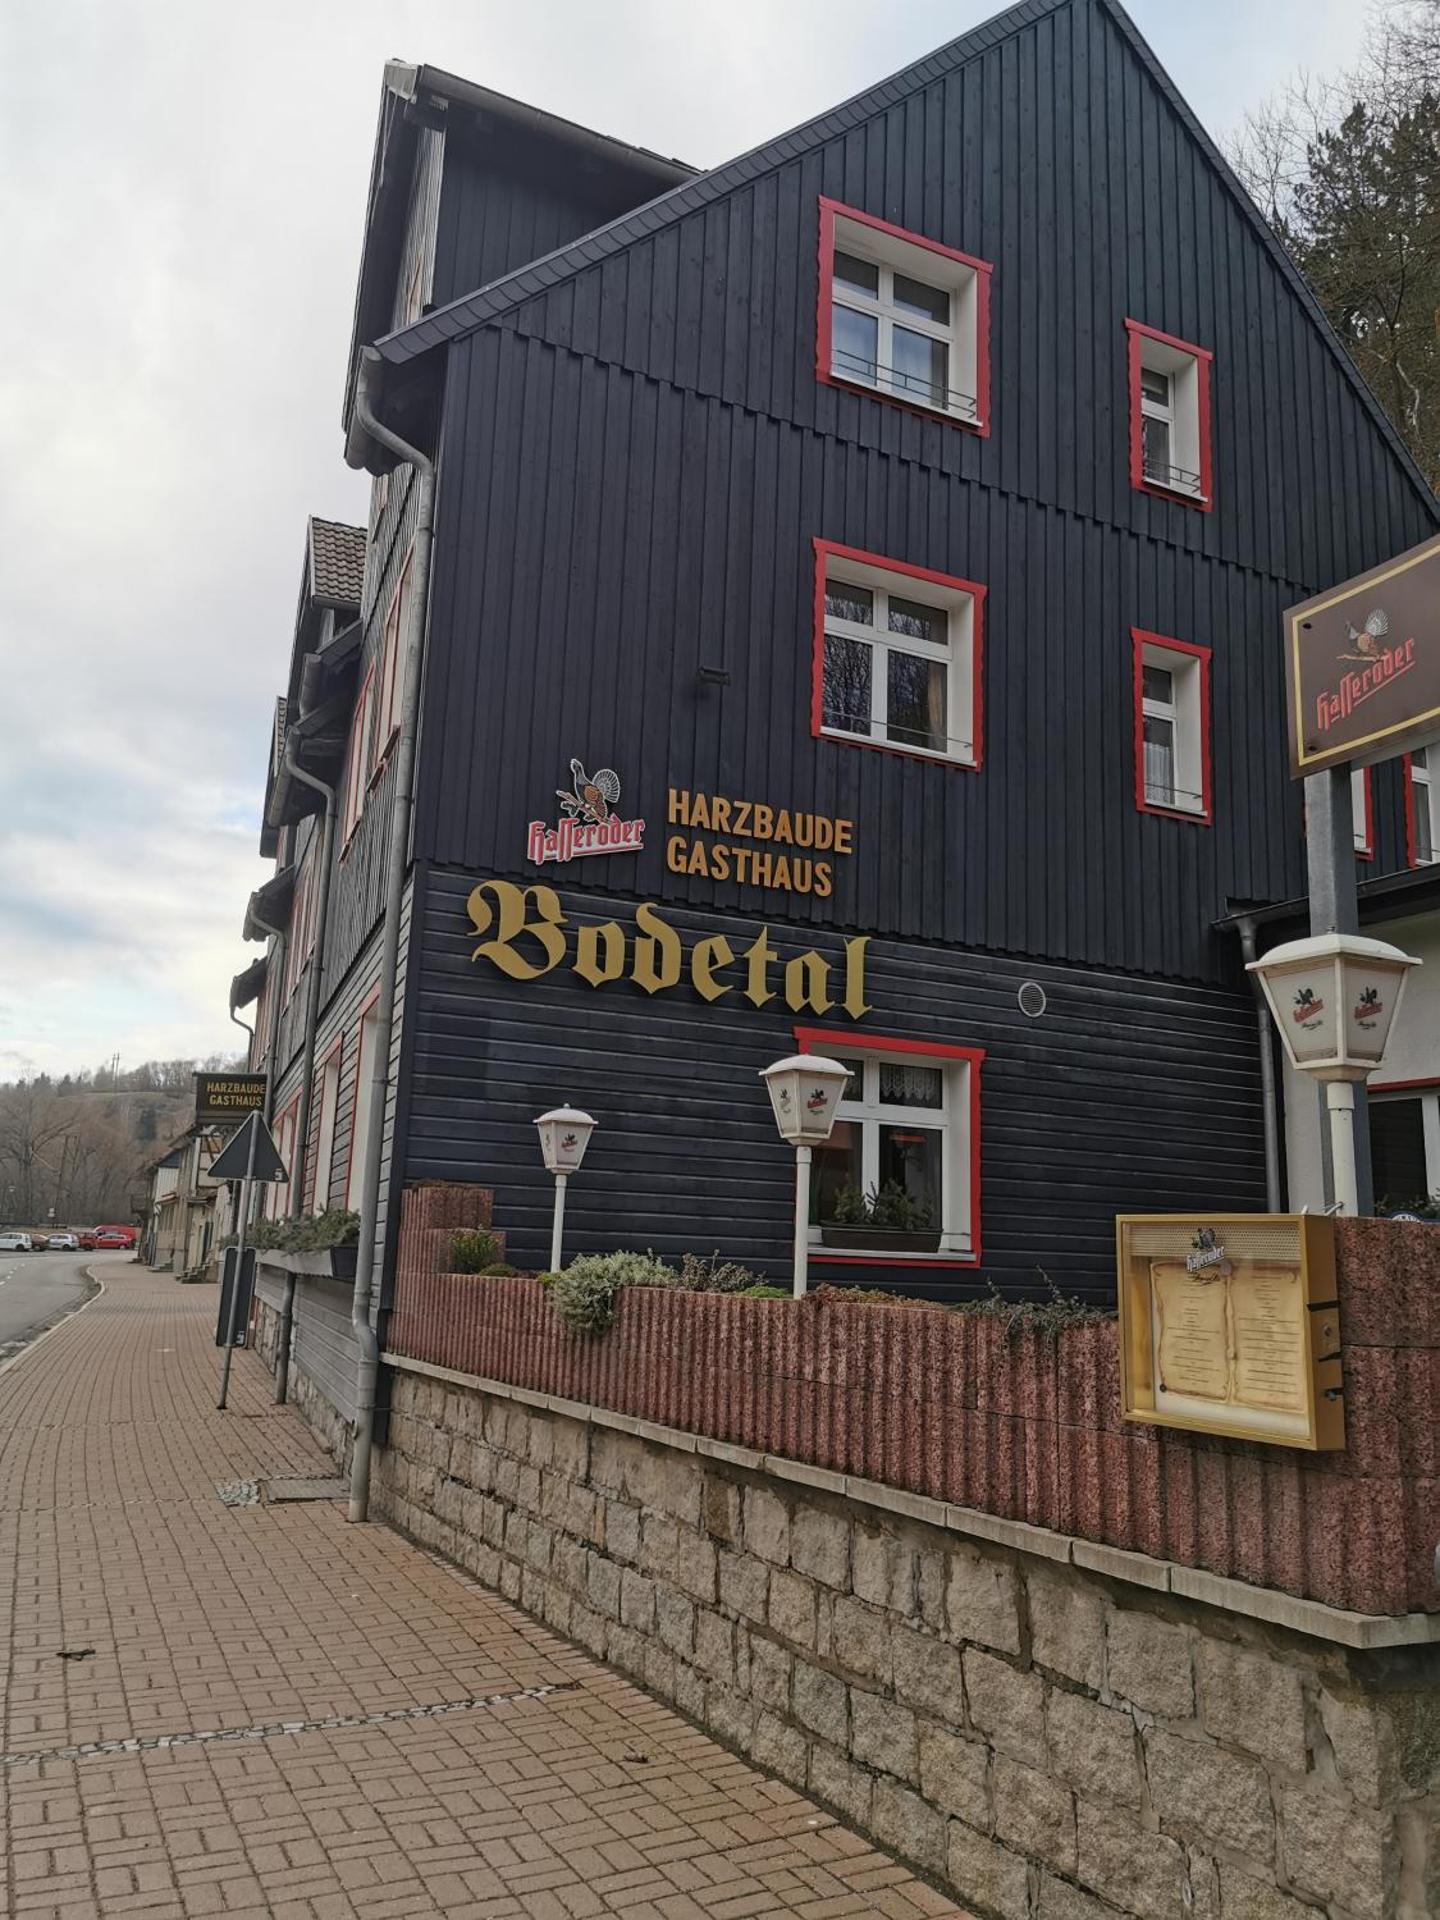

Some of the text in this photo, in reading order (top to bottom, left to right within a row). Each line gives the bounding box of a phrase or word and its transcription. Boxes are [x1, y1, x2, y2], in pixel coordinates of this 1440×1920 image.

[667, 788, 853, 854] HARZBAUDE
[666, 835, 833, 897] GASTHAUS
[466, 880, 873, 1020] Bodetal
[207, 1081, 266, 1094] HARZBAUDE
[209, 1095, 262, 1106] GASTHAUS
